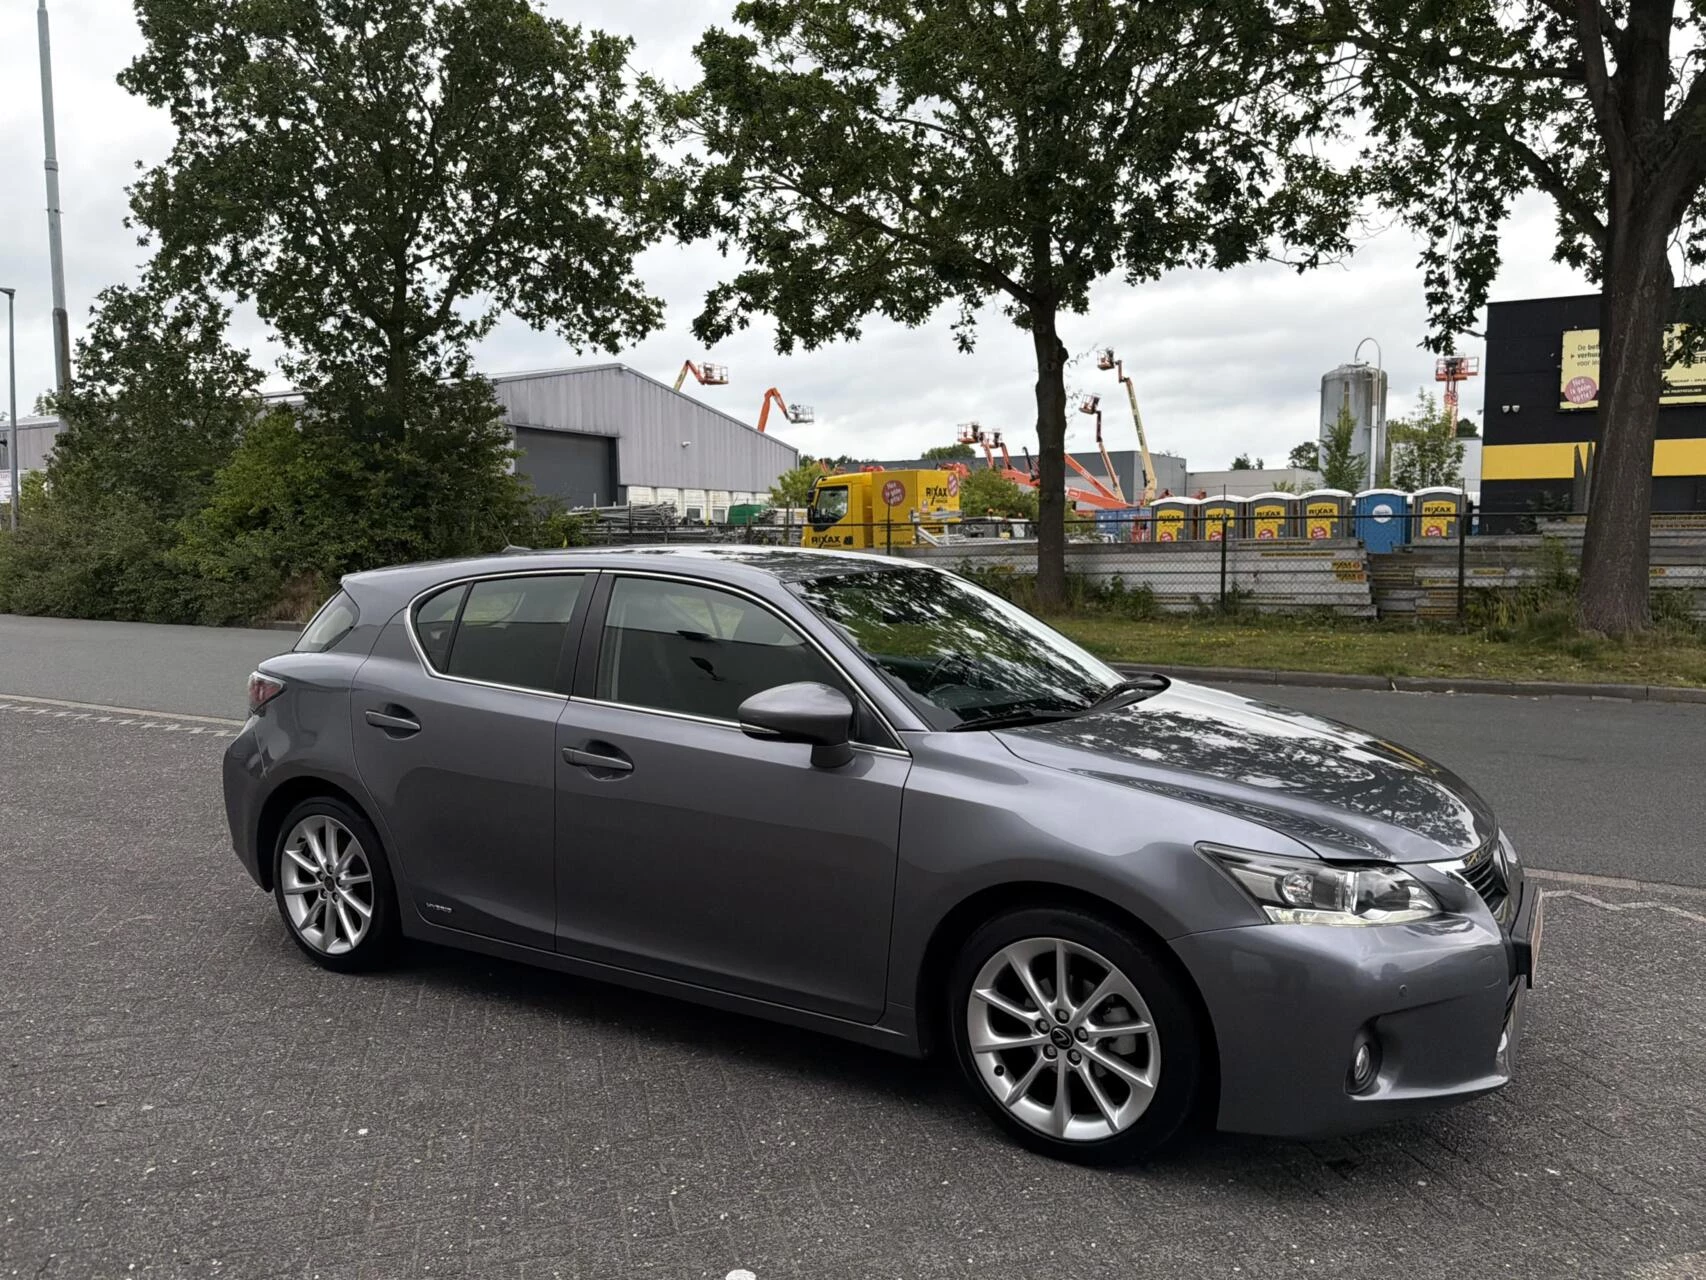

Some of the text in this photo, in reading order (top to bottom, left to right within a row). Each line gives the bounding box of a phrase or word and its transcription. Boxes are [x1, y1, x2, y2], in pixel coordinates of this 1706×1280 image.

[1308, 508, 1334, 516] RIXAX
[1424, 505, 1452, 514] RIXAX
[811, 534, 841, 548] RIXAX
